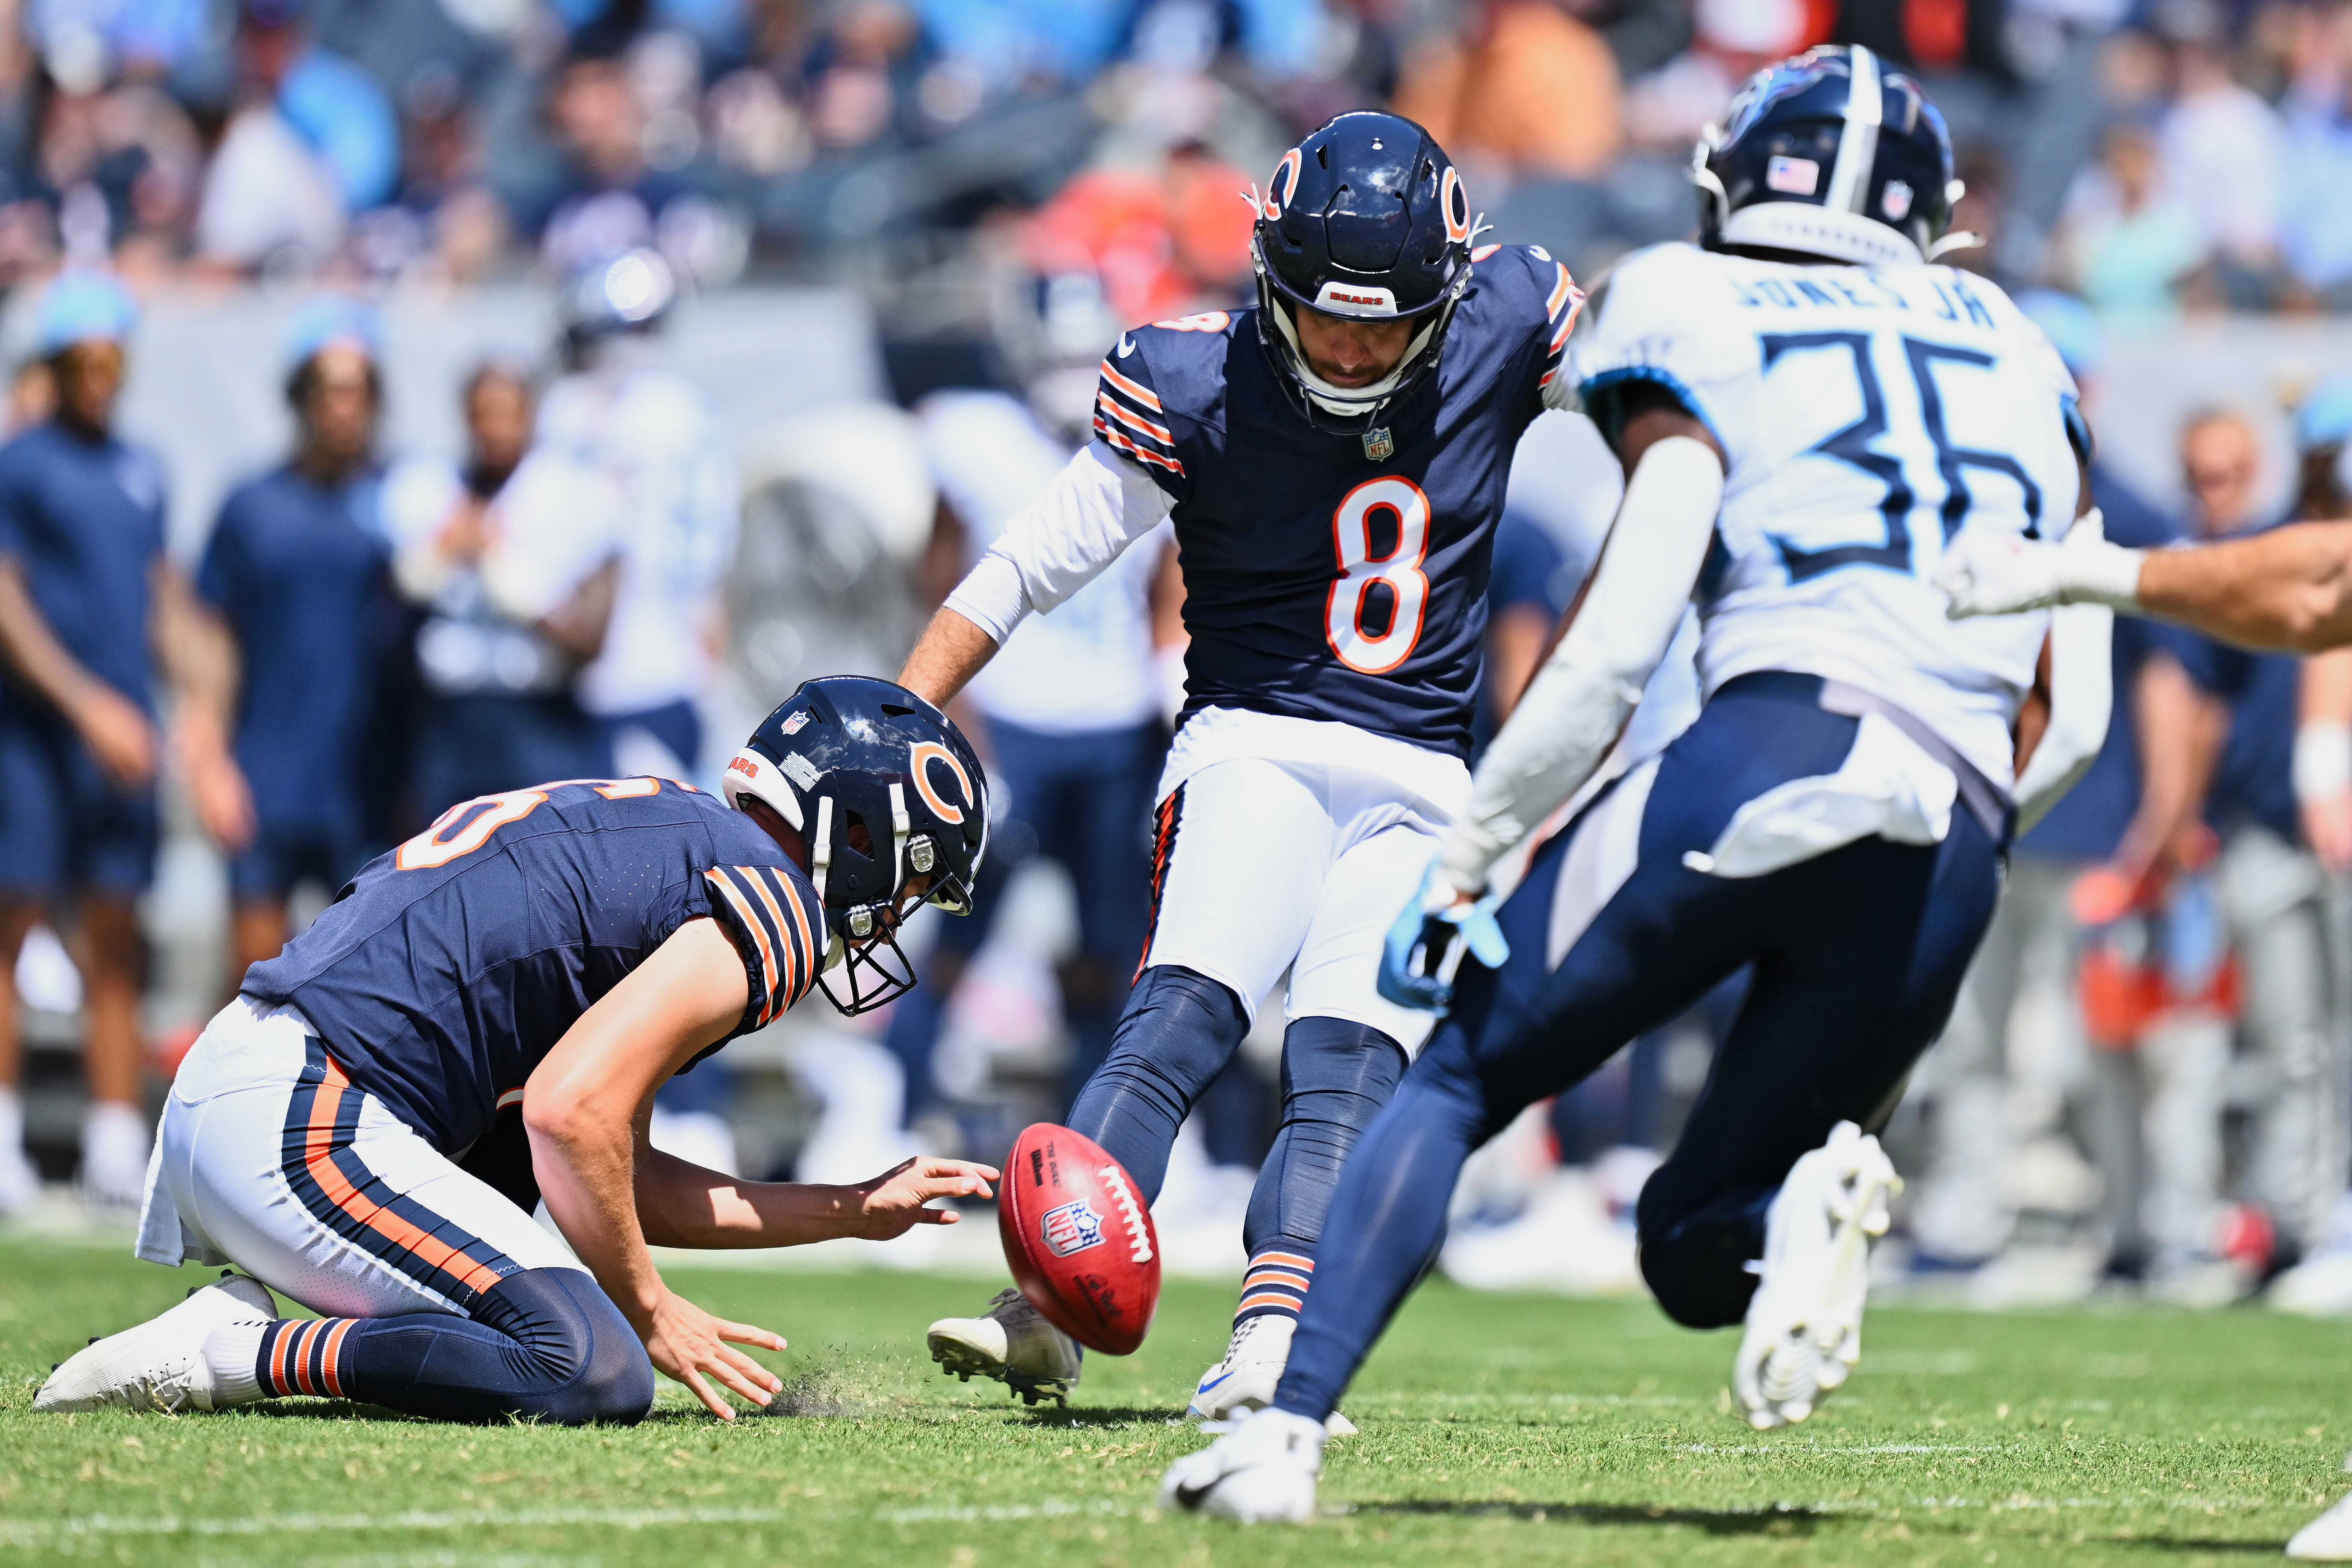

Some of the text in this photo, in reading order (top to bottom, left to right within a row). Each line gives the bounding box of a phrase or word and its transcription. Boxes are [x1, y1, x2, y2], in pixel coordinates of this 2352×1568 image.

[1330, 292, 1384, 305] BEARS
[1369, 442, 1390, 456] NFL
[1756, 332, 2041, 587] 36
[1324, 475, 1431, 674] 8
[785, 719, 798, 732] NFL
[727, 757, 759, 778] ARS
[1048, 1211, 1078, 1250] NFL
